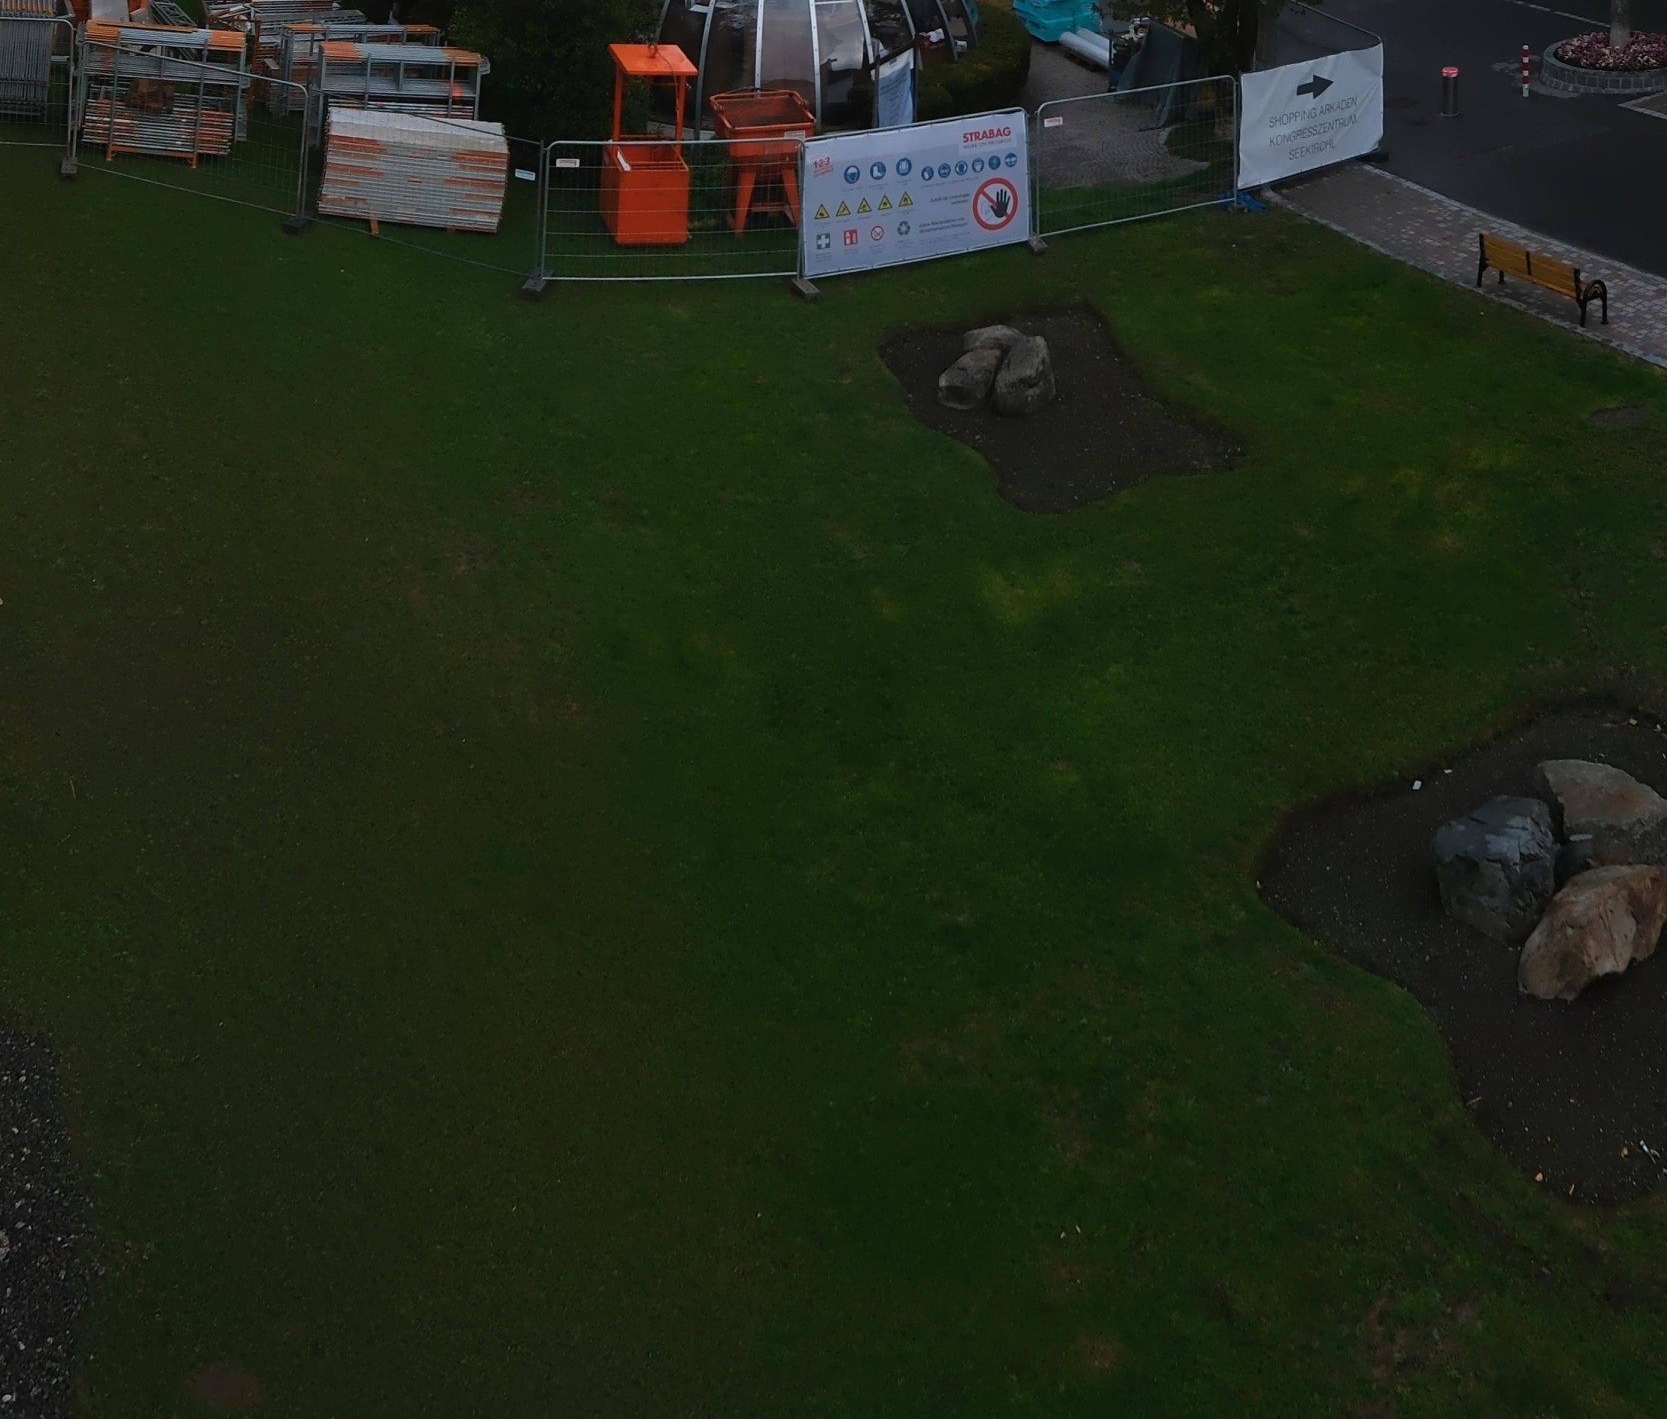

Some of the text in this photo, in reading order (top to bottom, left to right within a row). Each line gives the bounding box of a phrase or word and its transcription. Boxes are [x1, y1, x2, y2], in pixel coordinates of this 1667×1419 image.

[1268, 96, 1357, 129] SHOPPING ARKADEN
[963, 126, 1012, 143] STRABAG
[1269, 113, 1357, 148] KONGRESSZENTRUM
[1288, 138, 1336, 161] SEEKIRCHL
